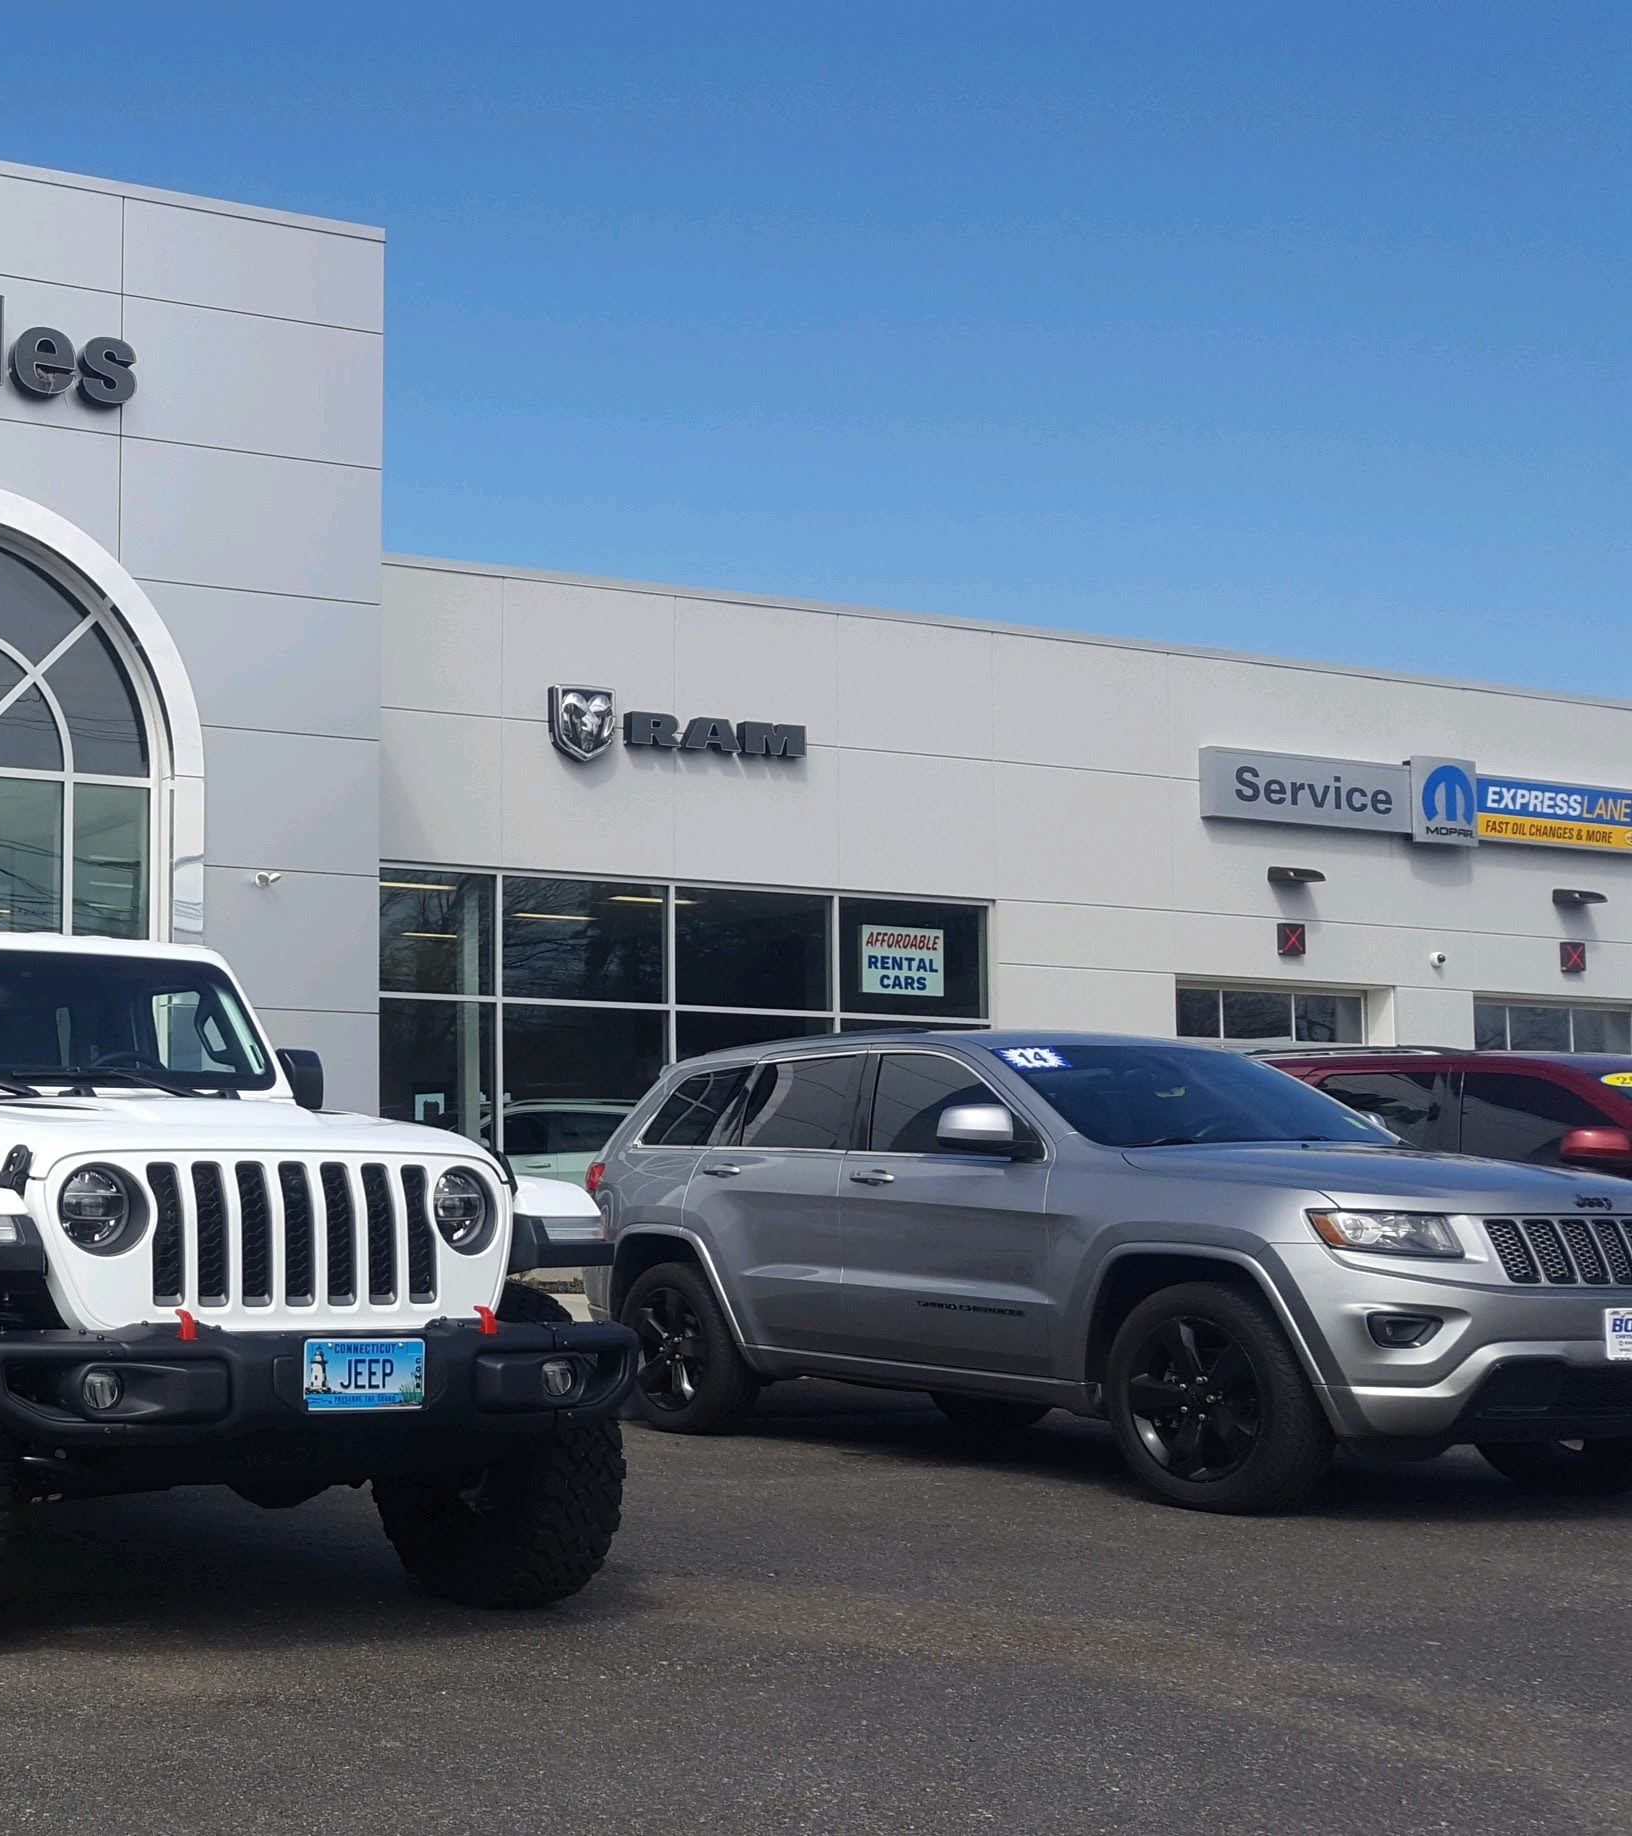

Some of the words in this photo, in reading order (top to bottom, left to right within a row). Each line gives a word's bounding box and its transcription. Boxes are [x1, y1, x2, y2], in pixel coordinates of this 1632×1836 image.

[623, 711, 808, 758] RAM
[1234, 765, 1393, 815] Service
[1426, 826, 1475, 839] MOPAR
[1485, 819, 1510, 834] FAST
[1511, 823, 1529, 836] OIL
[1528, 823, 1574, 841] CHANGES
[1575, 828, 1583, 841] &
[1585, 828, 1613, 844] MORE
[866, 931, 940, 951] AFFORDABLE
[868, 955, 939, 973] RENTAL
[879, 974, 927, 991] CARS
[1018, 1051, 1049, 1064] 14
[334, 1343, 396, 1354] CONNECTICUT
[340, 1358, 394, 1389] JEEP
